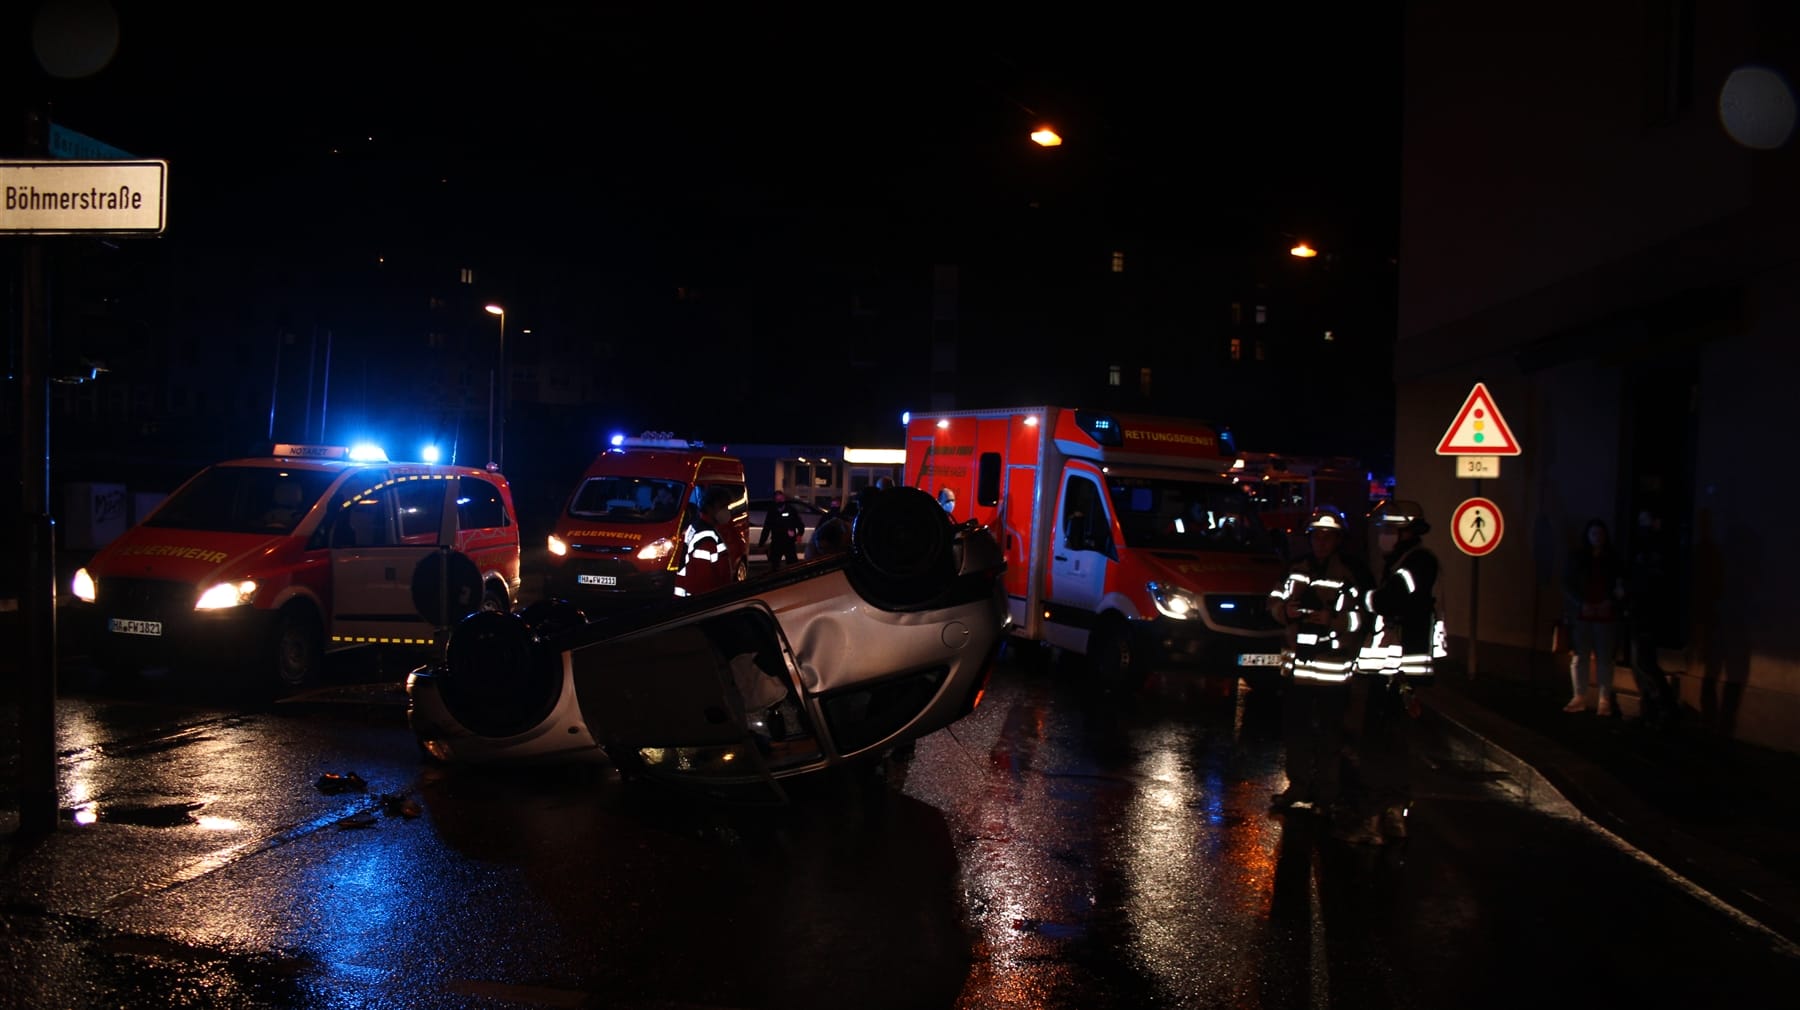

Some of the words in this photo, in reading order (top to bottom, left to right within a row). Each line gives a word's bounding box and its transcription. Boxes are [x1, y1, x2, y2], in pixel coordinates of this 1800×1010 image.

[6, 186, 142, 210] Böhmerstraße
[1125, 430, 1214, 446] RETTUNGSDIENST
[290, 448, 329, 456] NOTARZT
[567, 530, 642, 541] FEUERWEHR
